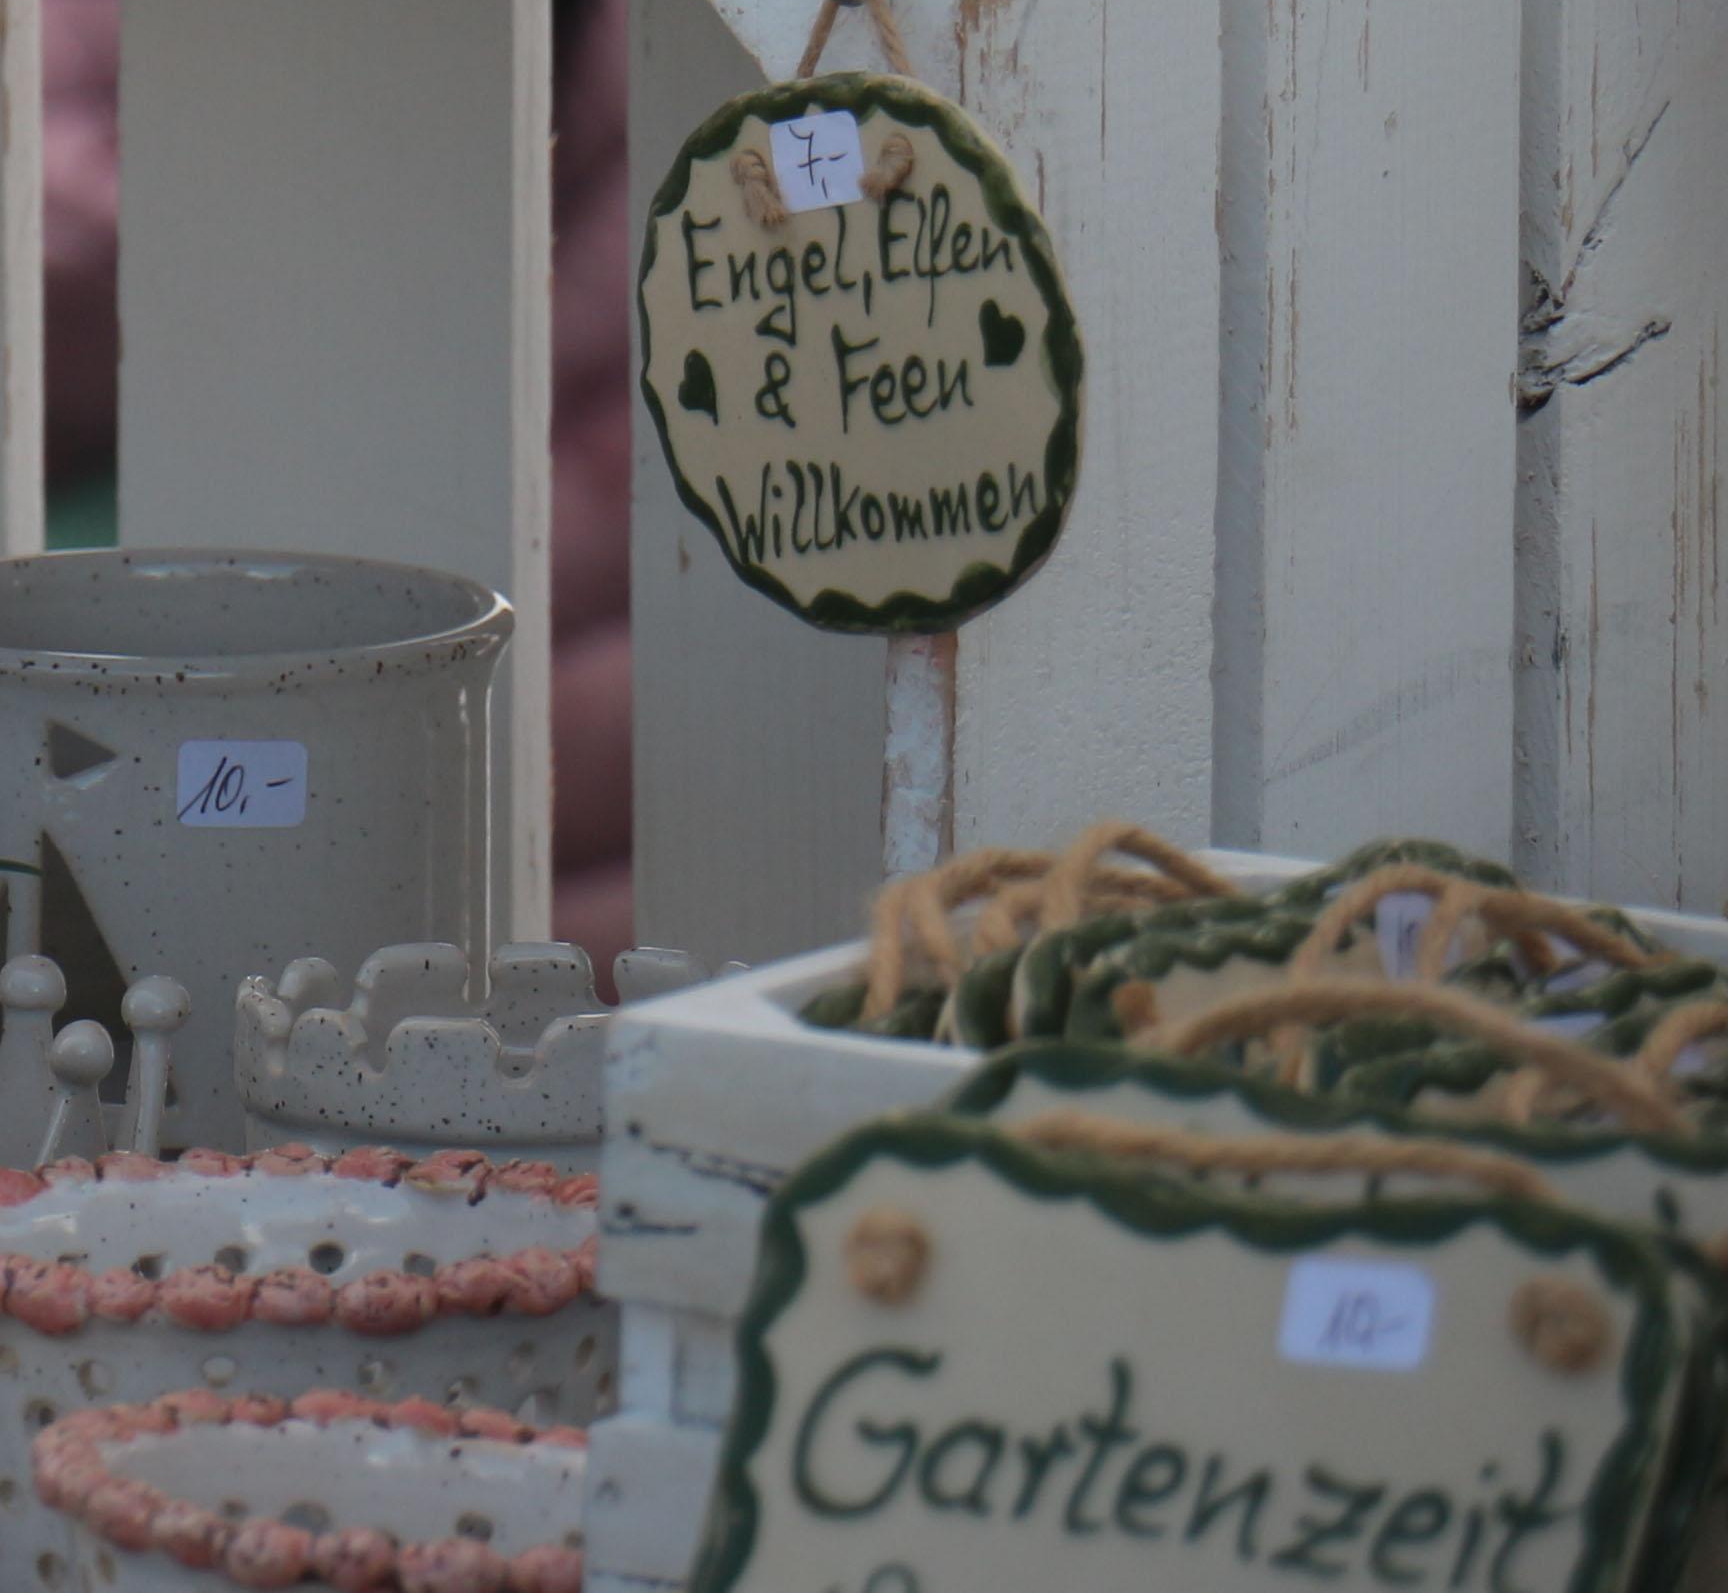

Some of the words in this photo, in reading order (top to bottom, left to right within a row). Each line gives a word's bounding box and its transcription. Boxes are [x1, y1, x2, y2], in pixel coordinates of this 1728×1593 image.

[755, 350, 796, 429] &
[831, 324, 975, 435] Feen
[715, 459, 1040, 564] Willkommen
[177, 757, 296, 822] 10,-
[791, 1347, 1584, 1593] Gartenzeit
